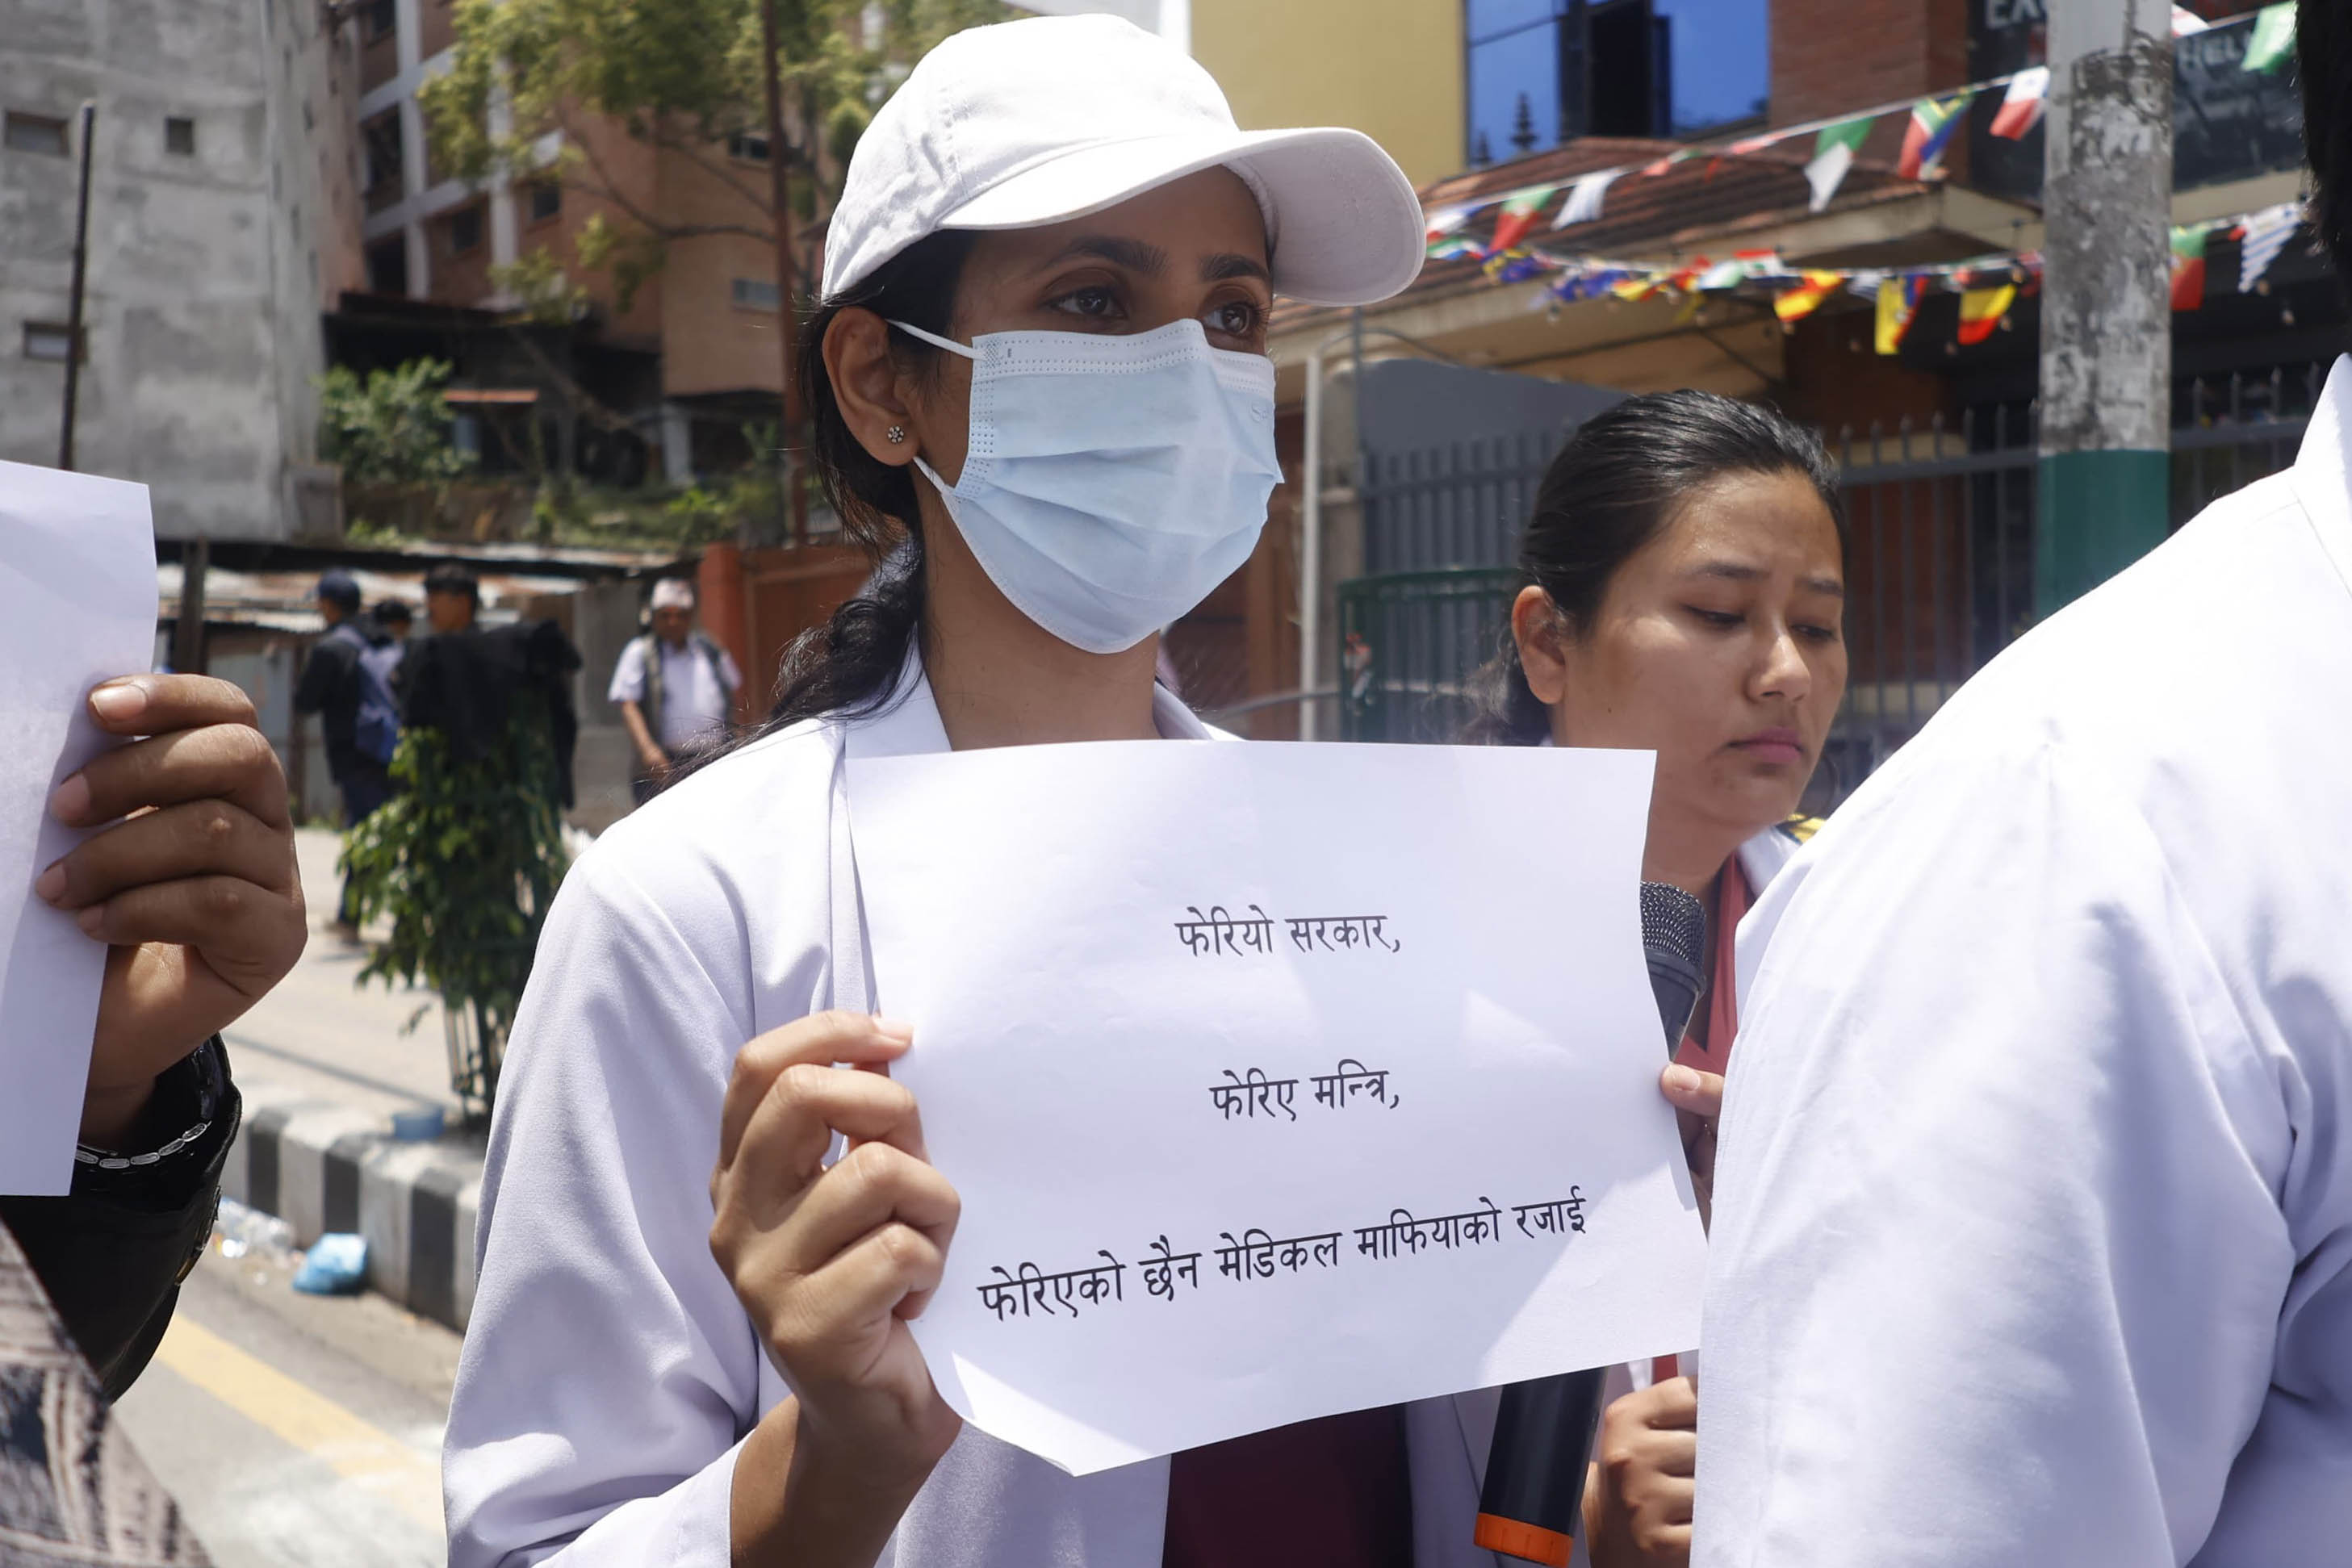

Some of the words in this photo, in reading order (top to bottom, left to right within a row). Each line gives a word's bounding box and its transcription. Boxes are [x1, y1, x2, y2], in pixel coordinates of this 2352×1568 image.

[1174, 904, 1275, 957] फेरियो
[1283, 914, 1401, 954] सरकार,
[1207, 1066, 1300, 1123] फेरिए
[1308, 1058, 1400, 1110] मन्त्रि,
[975, 1248, 1128, 1322] फेरिएको
[1136, 1233, 1203, 1302] छैन
[1212, 1227, 1345, 1283] मेडिकल
[1352, 1195, 1504, 1261] माफियाको
[1509, 1184, 1588, 1240] रजाई
